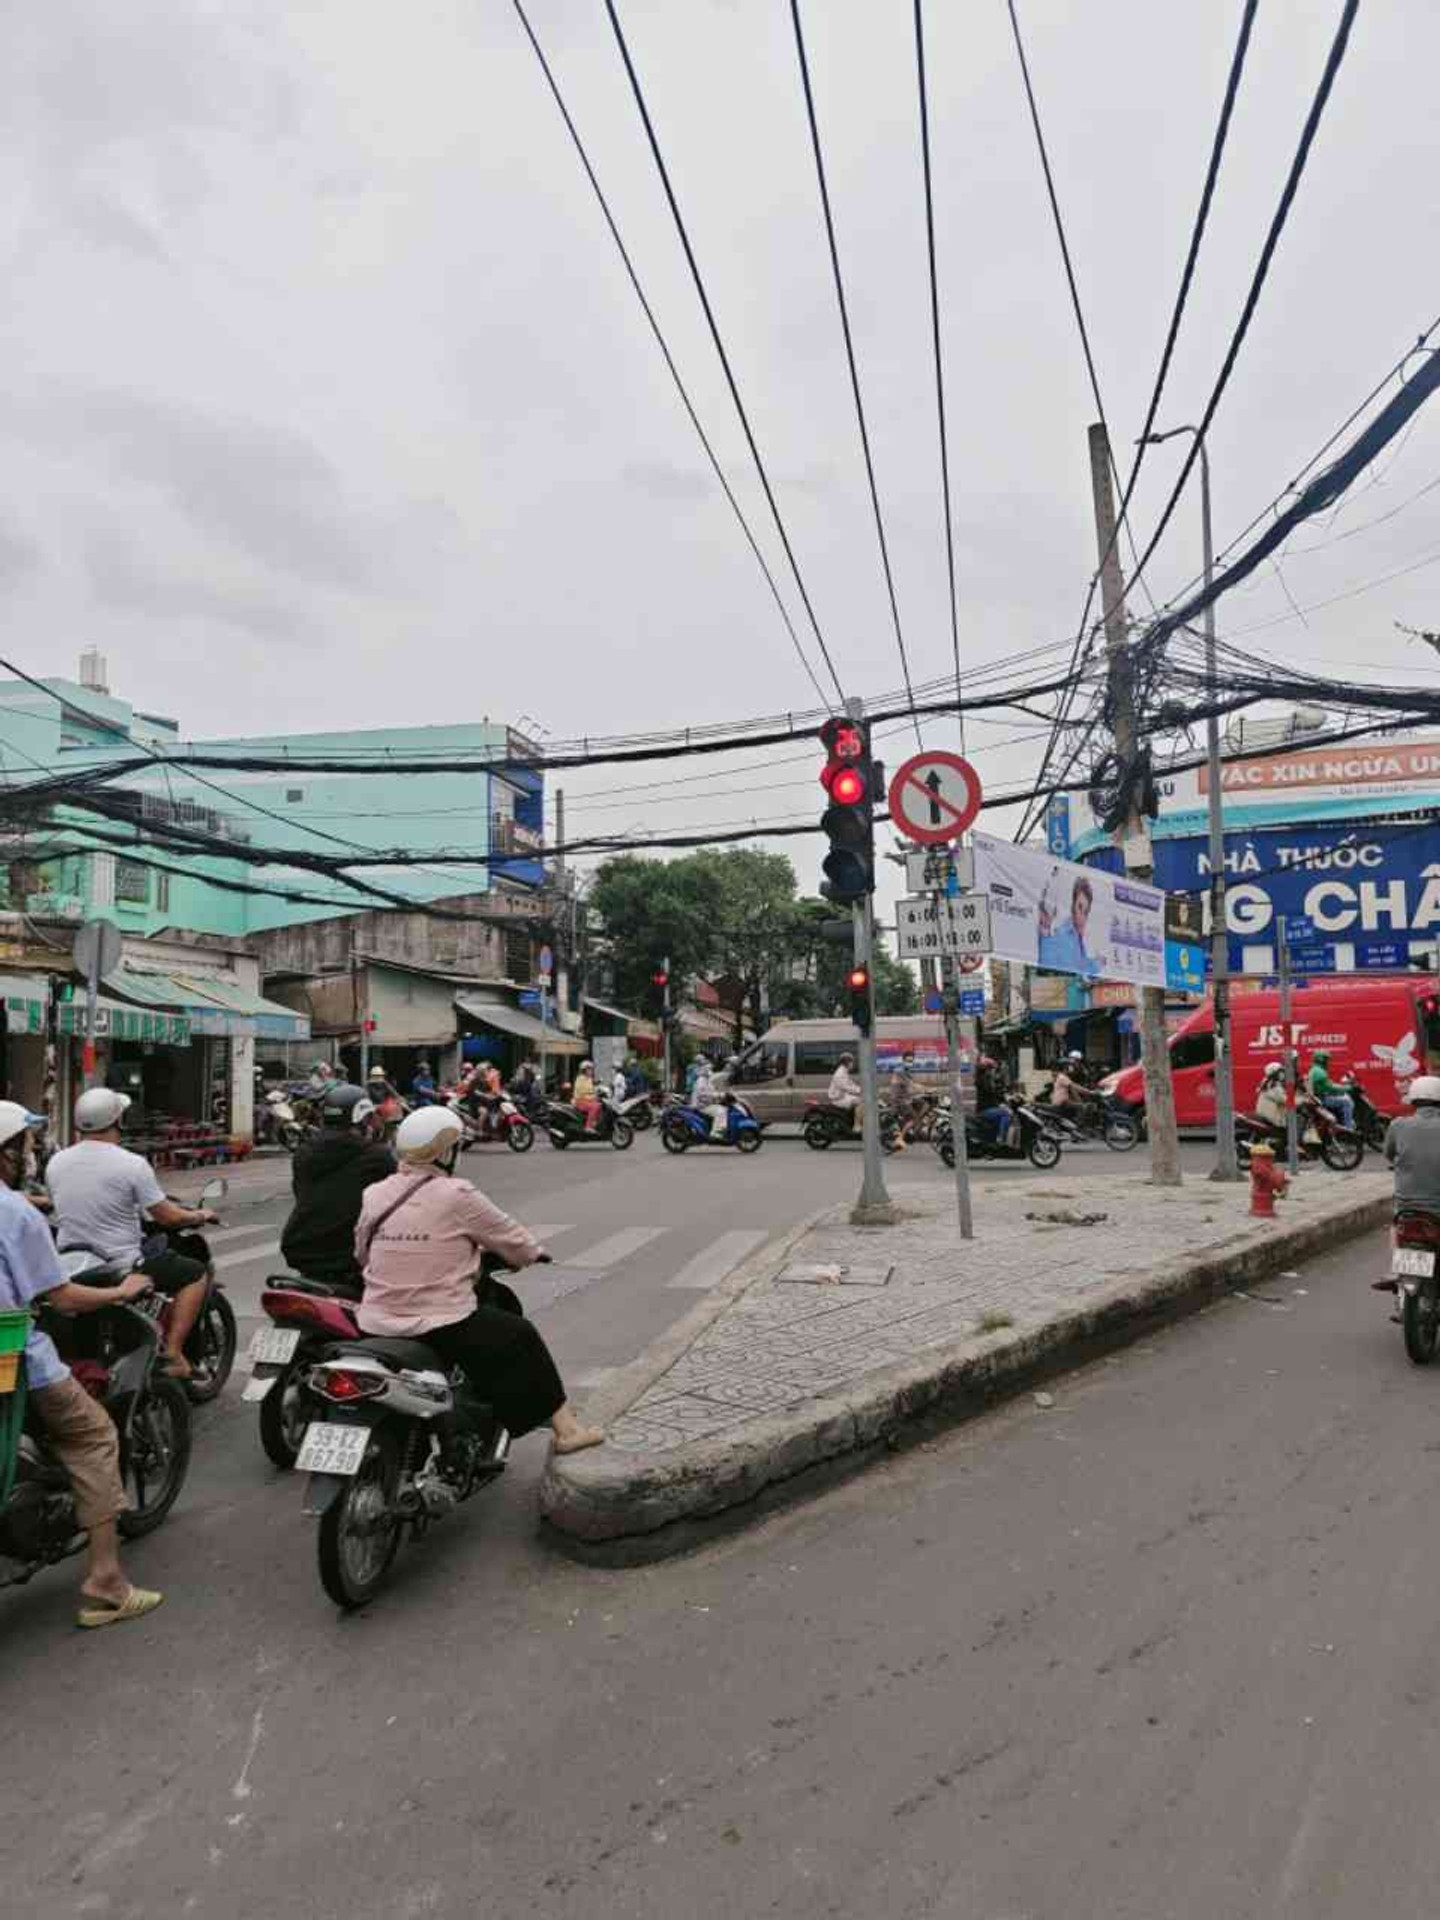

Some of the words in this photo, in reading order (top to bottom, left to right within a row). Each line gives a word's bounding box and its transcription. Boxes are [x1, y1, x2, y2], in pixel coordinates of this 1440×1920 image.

[1272, 764, 1316, 781] XIN
[1197, 843, 1261, 875] NHÀ
[1276, 834, 1383, 870] THUỐC
